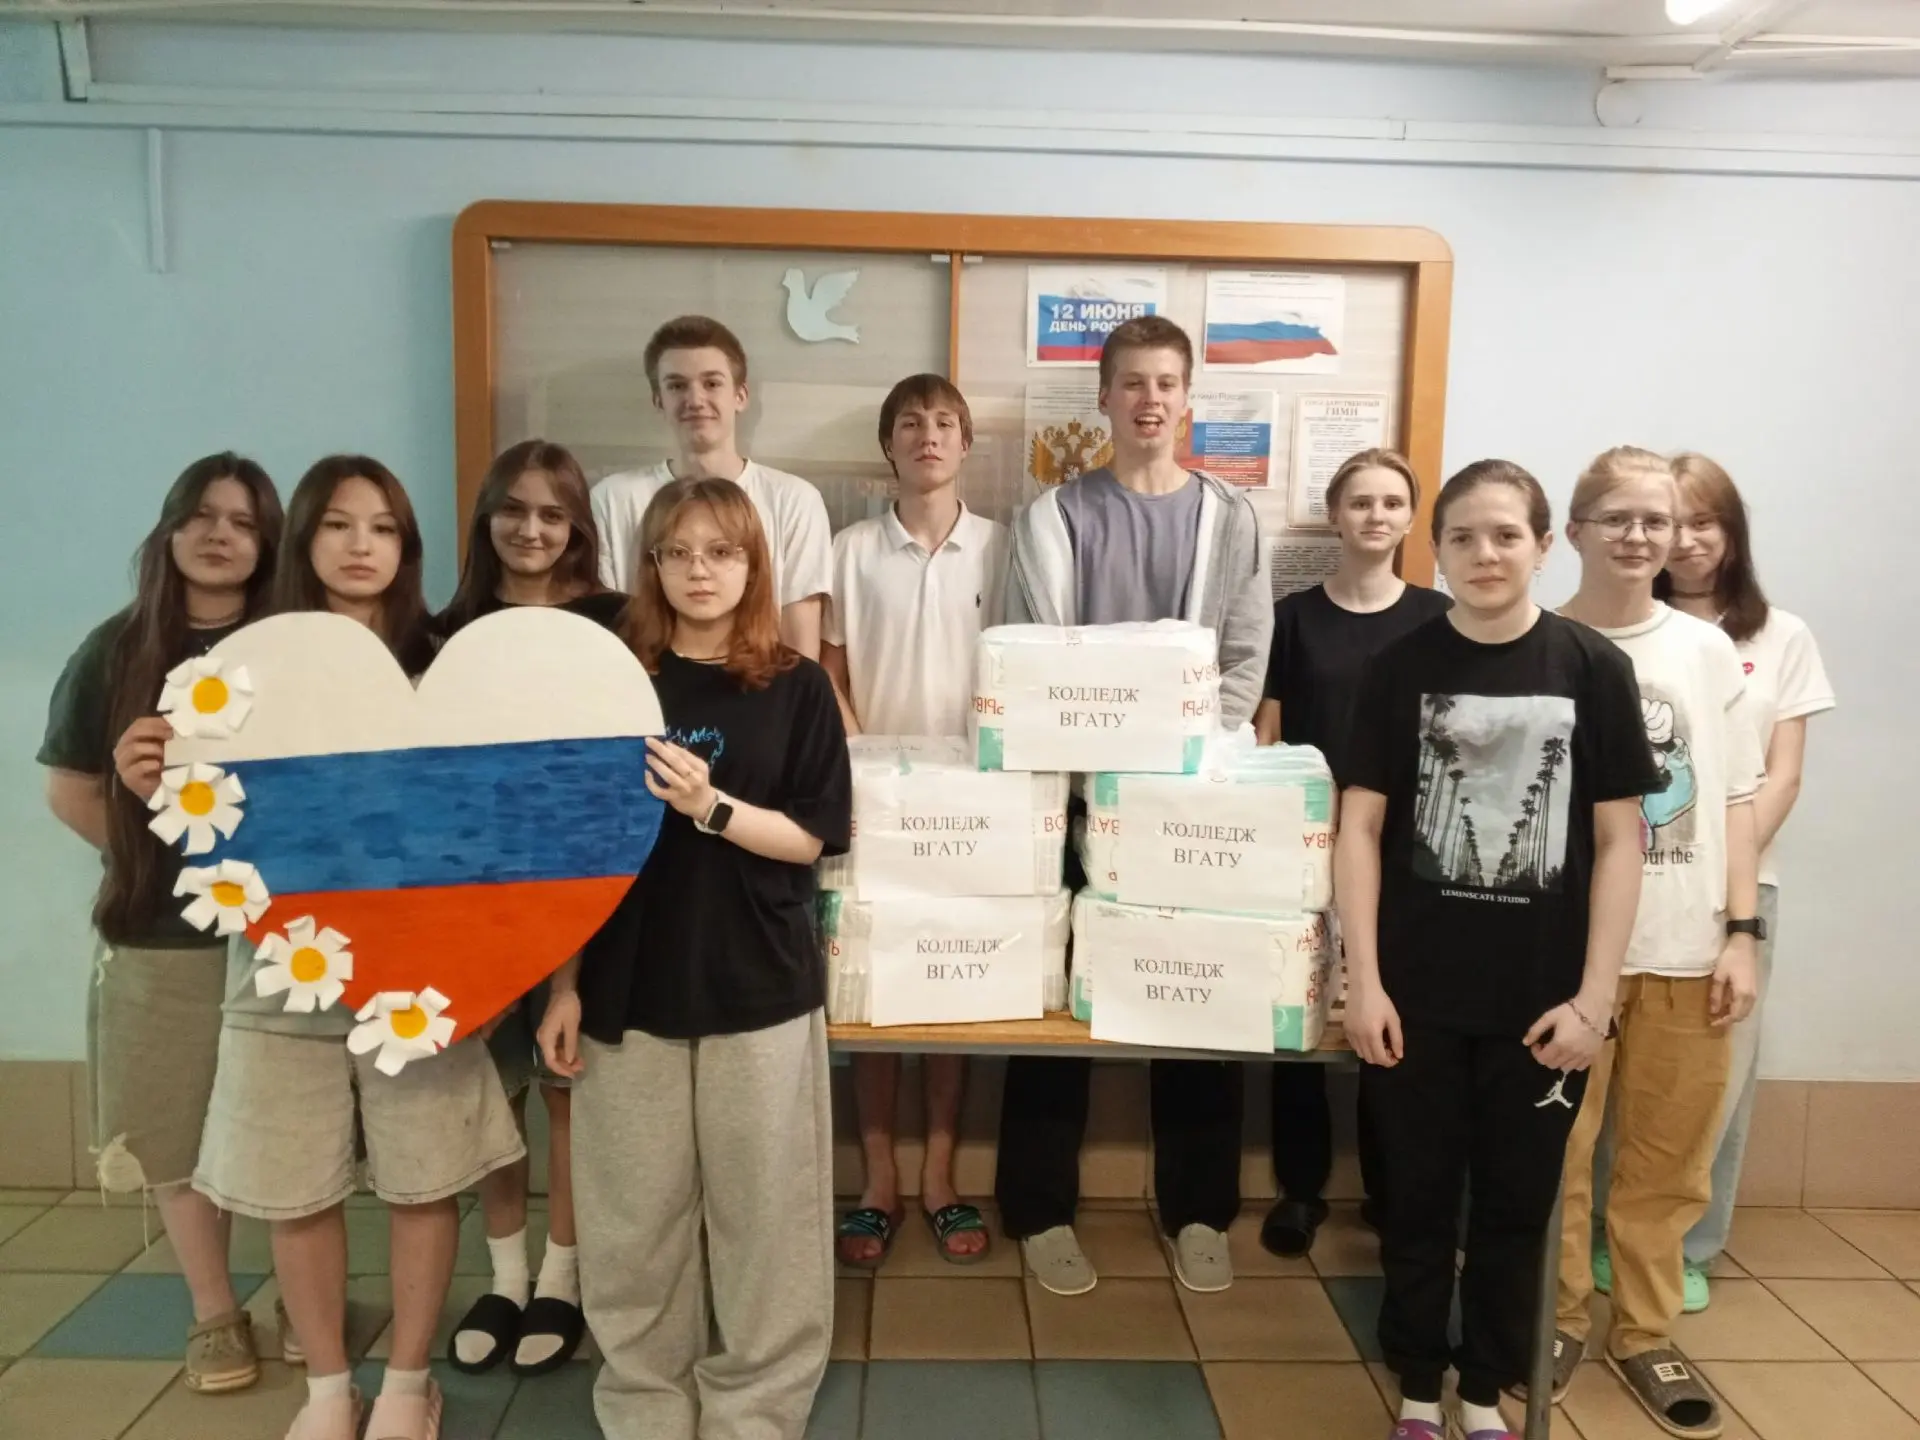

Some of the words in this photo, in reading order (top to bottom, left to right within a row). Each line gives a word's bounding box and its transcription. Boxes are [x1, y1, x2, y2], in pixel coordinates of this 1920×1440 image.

[1051, 303, 1075, 320] 12
[1080, 303, 1145, 320] ИЮНЯ
[1049, 320, 1087, 333] ДЕНЬ
[1090, 321, 1122, 333] РОС
[1048, 685, 1140, 703] КОЛЛЕДЖ
[1060, 711, 1127, 728] ВГАТУ
[900, 815, 991, 832] КОЛЛЕДЖ
[1162, 821, 1257, 844] КОЛЛЕДЖ
[913, 840, 978, 857] ВГАТУ
[1671, 846, 1693, 865] the
[1174, 847, 1242, 868] ВГАТУ
[1496, 894, 1531, 904] STUDIO
[916, 938, 1004, 954] КОЛЛЕДЖ
[927, 963, 990, 980] ВГАТУ
[1134, 958, 1225, 979] КОЛЛЕДЖ
[1146, 984, 1212, 1004] ВГАТУ
